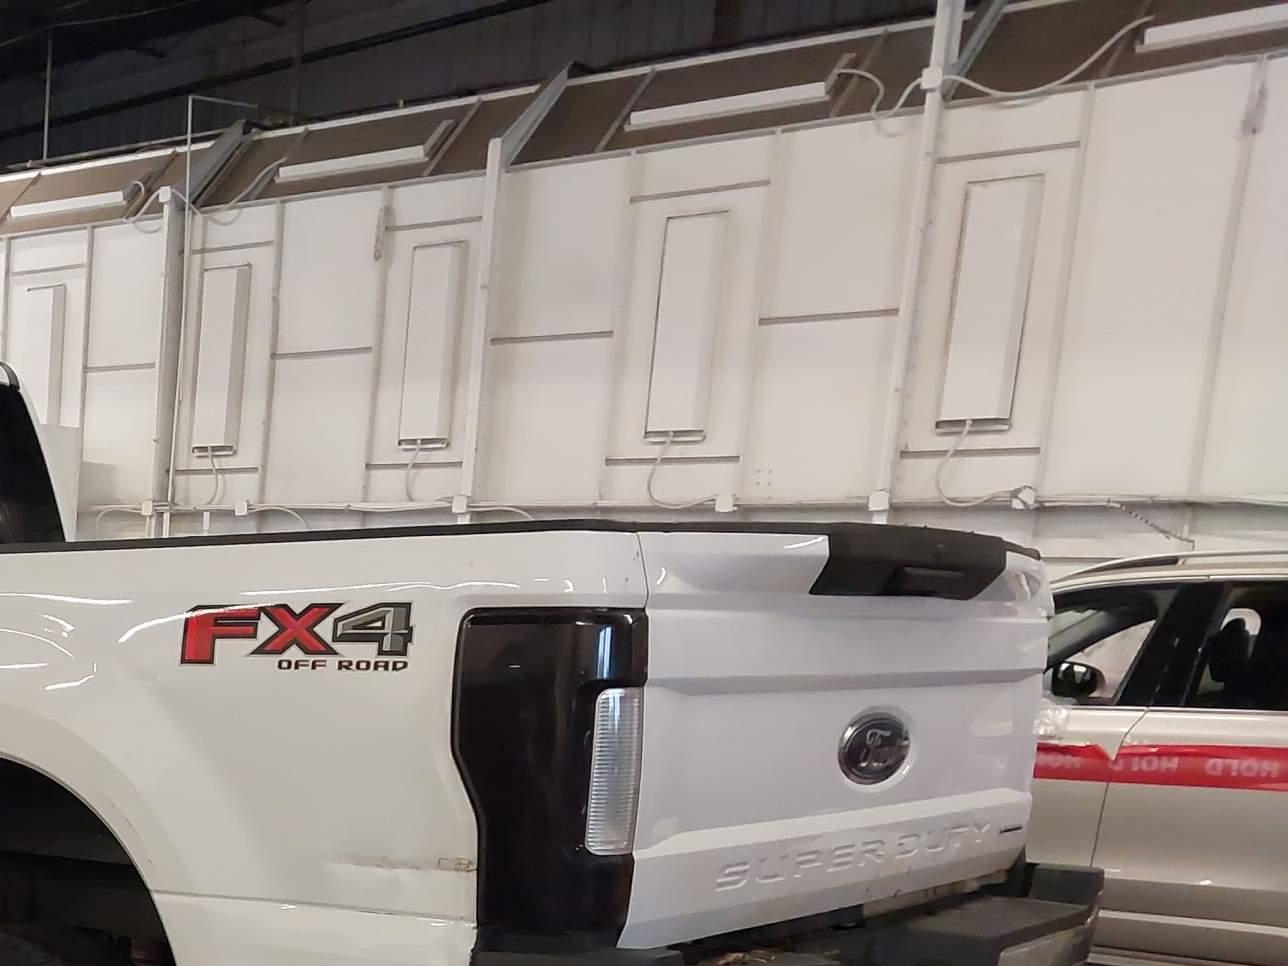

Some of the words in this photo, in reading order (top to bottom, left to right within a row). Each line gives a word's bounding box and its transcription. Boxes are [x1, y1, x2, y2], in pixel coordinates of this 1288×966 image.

[180, 602, 414, 665] FX4
[277, 659, 327, 671] OFF
[337, 660, 409, 672] ROAD
[1205, 758, 1281, 778] HOLD
[714, 839, 886, 892] SUPER
[896, 822, 991, 860] DUTY
